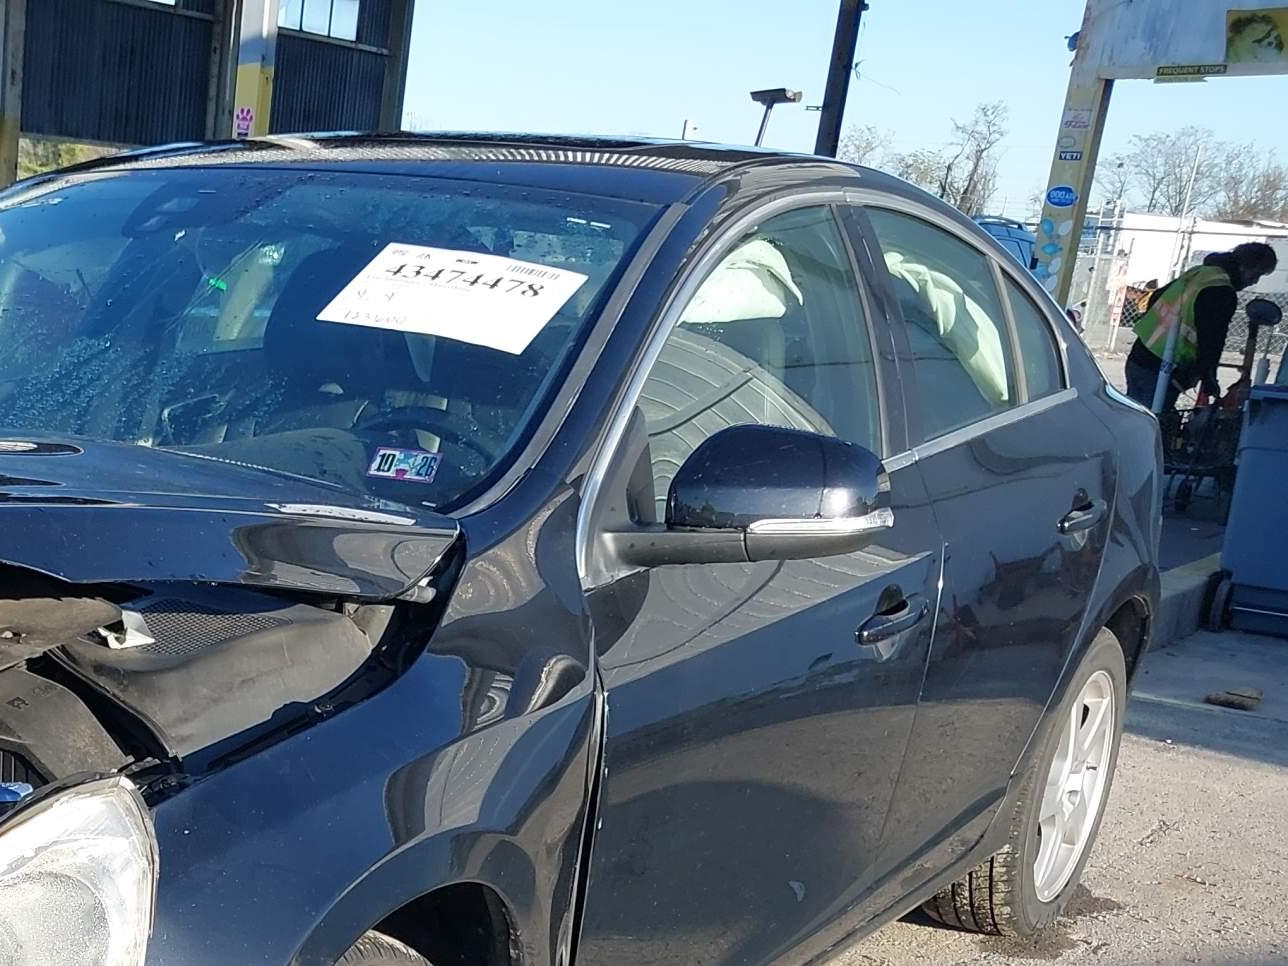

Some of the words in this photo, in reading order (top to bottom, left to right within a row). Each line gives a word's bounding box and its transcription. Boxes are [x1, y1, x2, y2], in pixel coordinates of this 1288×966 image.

[1060, 152, 1081, 160] YETI
[385, 263, 546, 298] 43474478
[374, 452, 397, 473] 10
